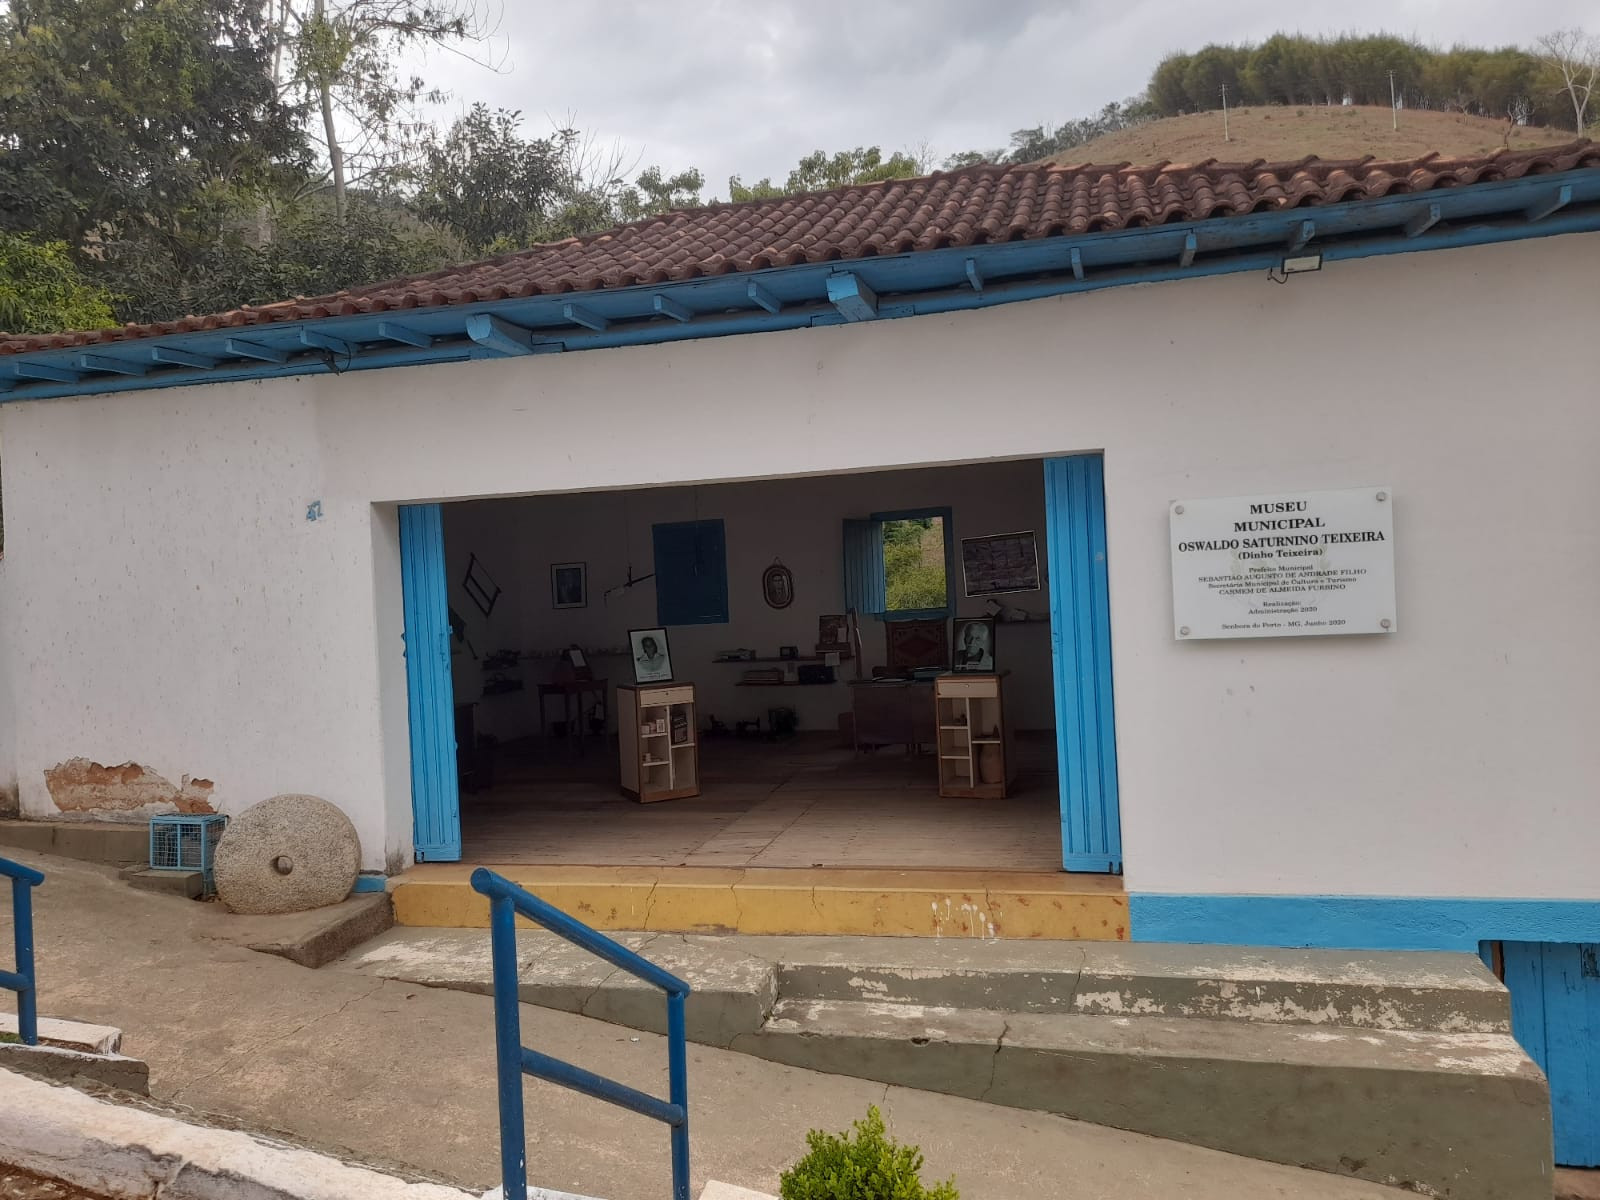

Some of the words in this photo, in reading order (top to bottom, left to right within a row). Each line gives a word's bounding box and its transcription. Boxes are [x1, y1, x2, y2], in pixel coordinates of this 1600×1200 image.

[1250, 501, 1307, 514] MUSEU
[1234, 517, 1325, 532] MUNICIPAL
[1178, 538, 1239, 552] OSWALDO
[1242, 534, 1318, 549] SATURNINO
[1321, 531, 1385, 545] TEIXEIRA
[1238, 551, 1273, 560] (Dinho
[1277, 549, 1323, 558] Teixeira)
